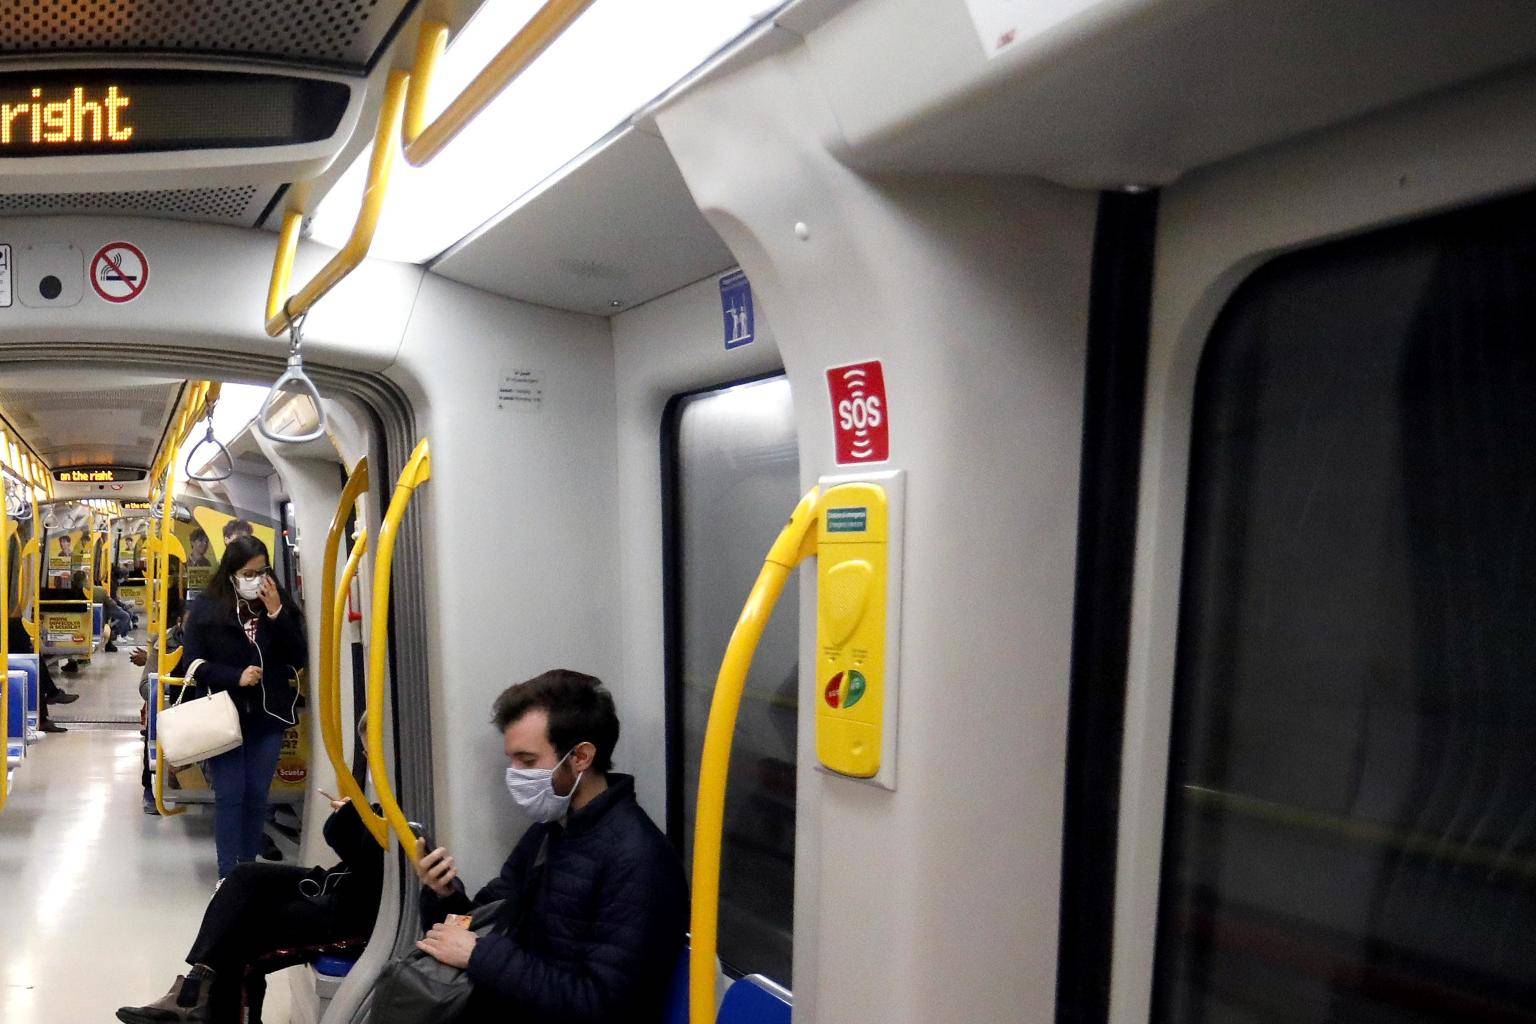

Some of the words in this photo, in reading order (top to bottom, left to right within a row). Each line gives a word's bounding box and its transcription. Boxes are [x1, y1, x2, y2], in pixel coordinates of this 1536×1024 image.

[1, 86, 133, 143] right
[838, 395, 881, 430] SOS
[72, 471, 88, 480] the
[90, 471, 113, 480] right
